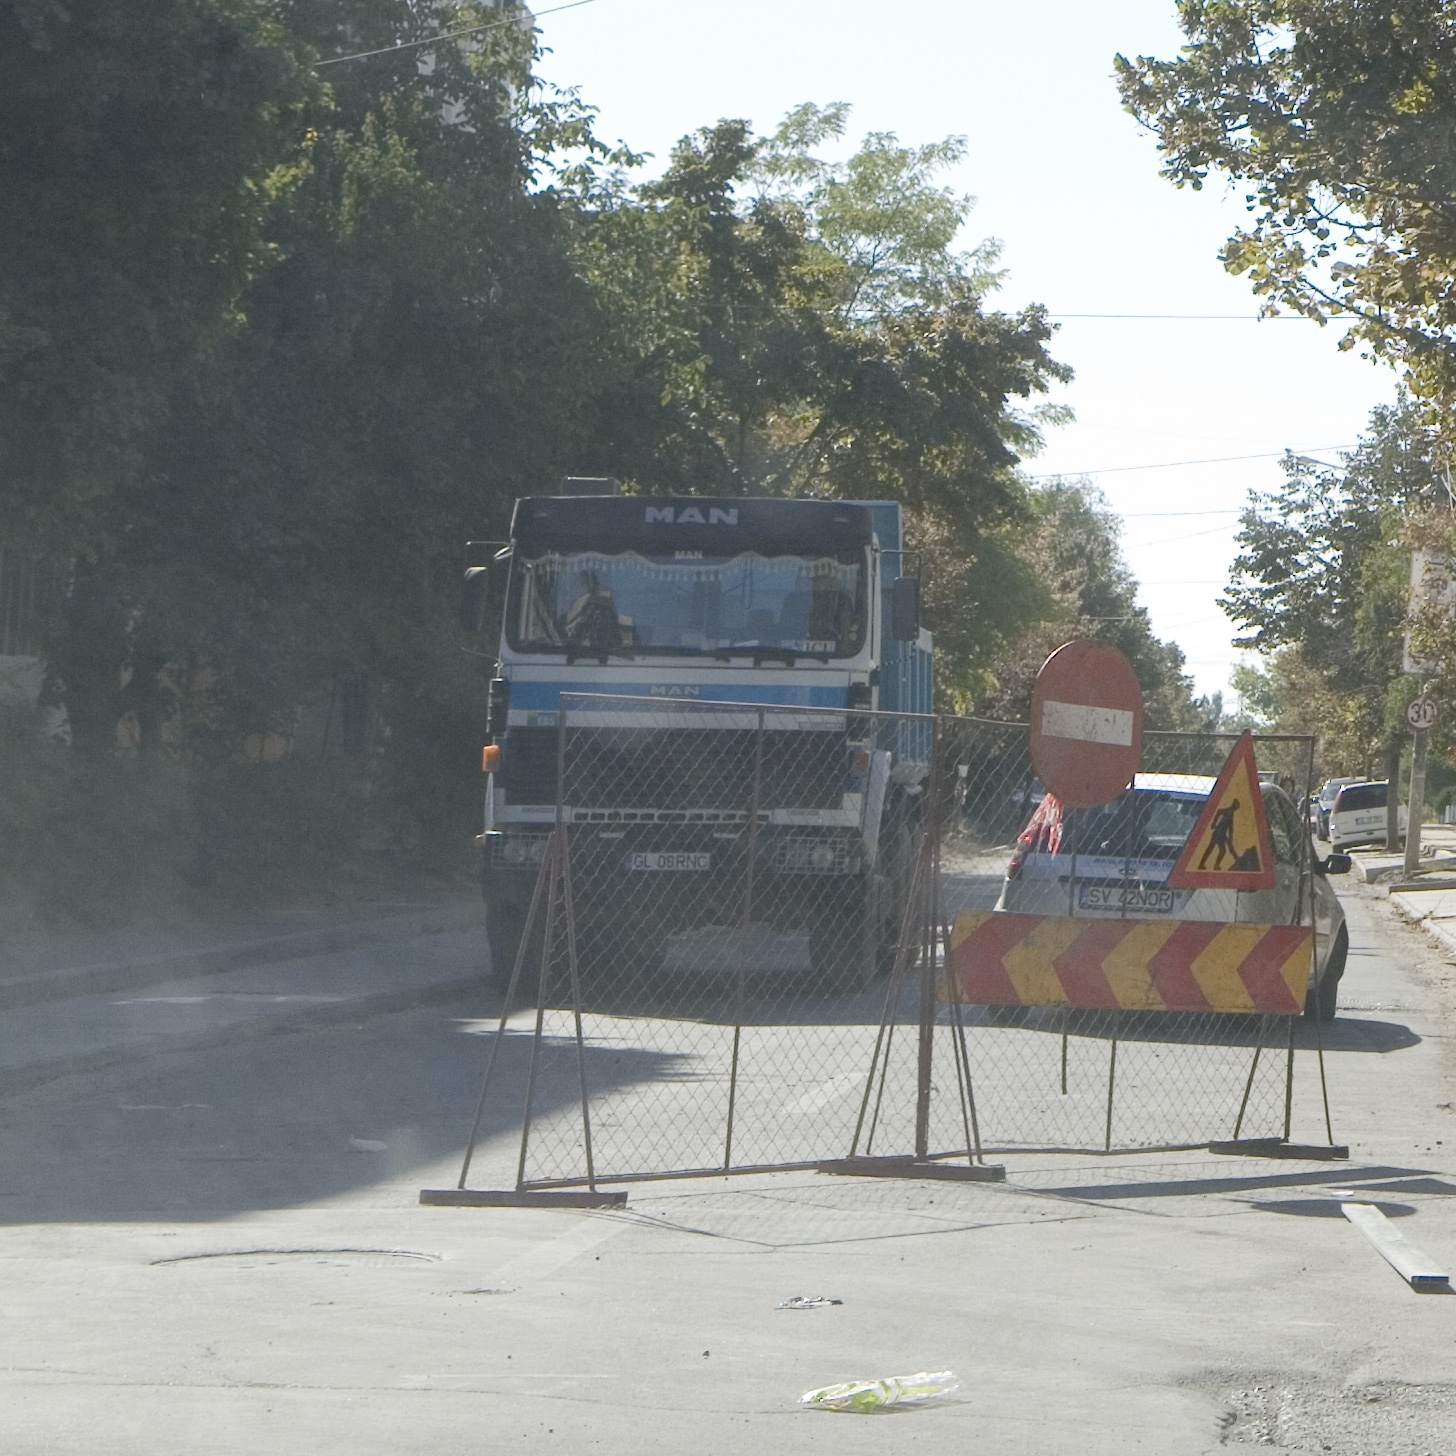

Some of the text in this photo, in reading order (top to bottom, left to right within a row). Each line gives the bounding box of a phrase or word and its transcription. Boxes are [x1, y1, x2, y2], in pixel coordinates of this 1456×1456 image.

[644, 507, 739, 525] MAN
[650, 686, 700, 696] MAN
[1410, 703, 1435, 724] 30
[633, 854, 651, 869] GL
[1089, 888, 1112, 904] SV
